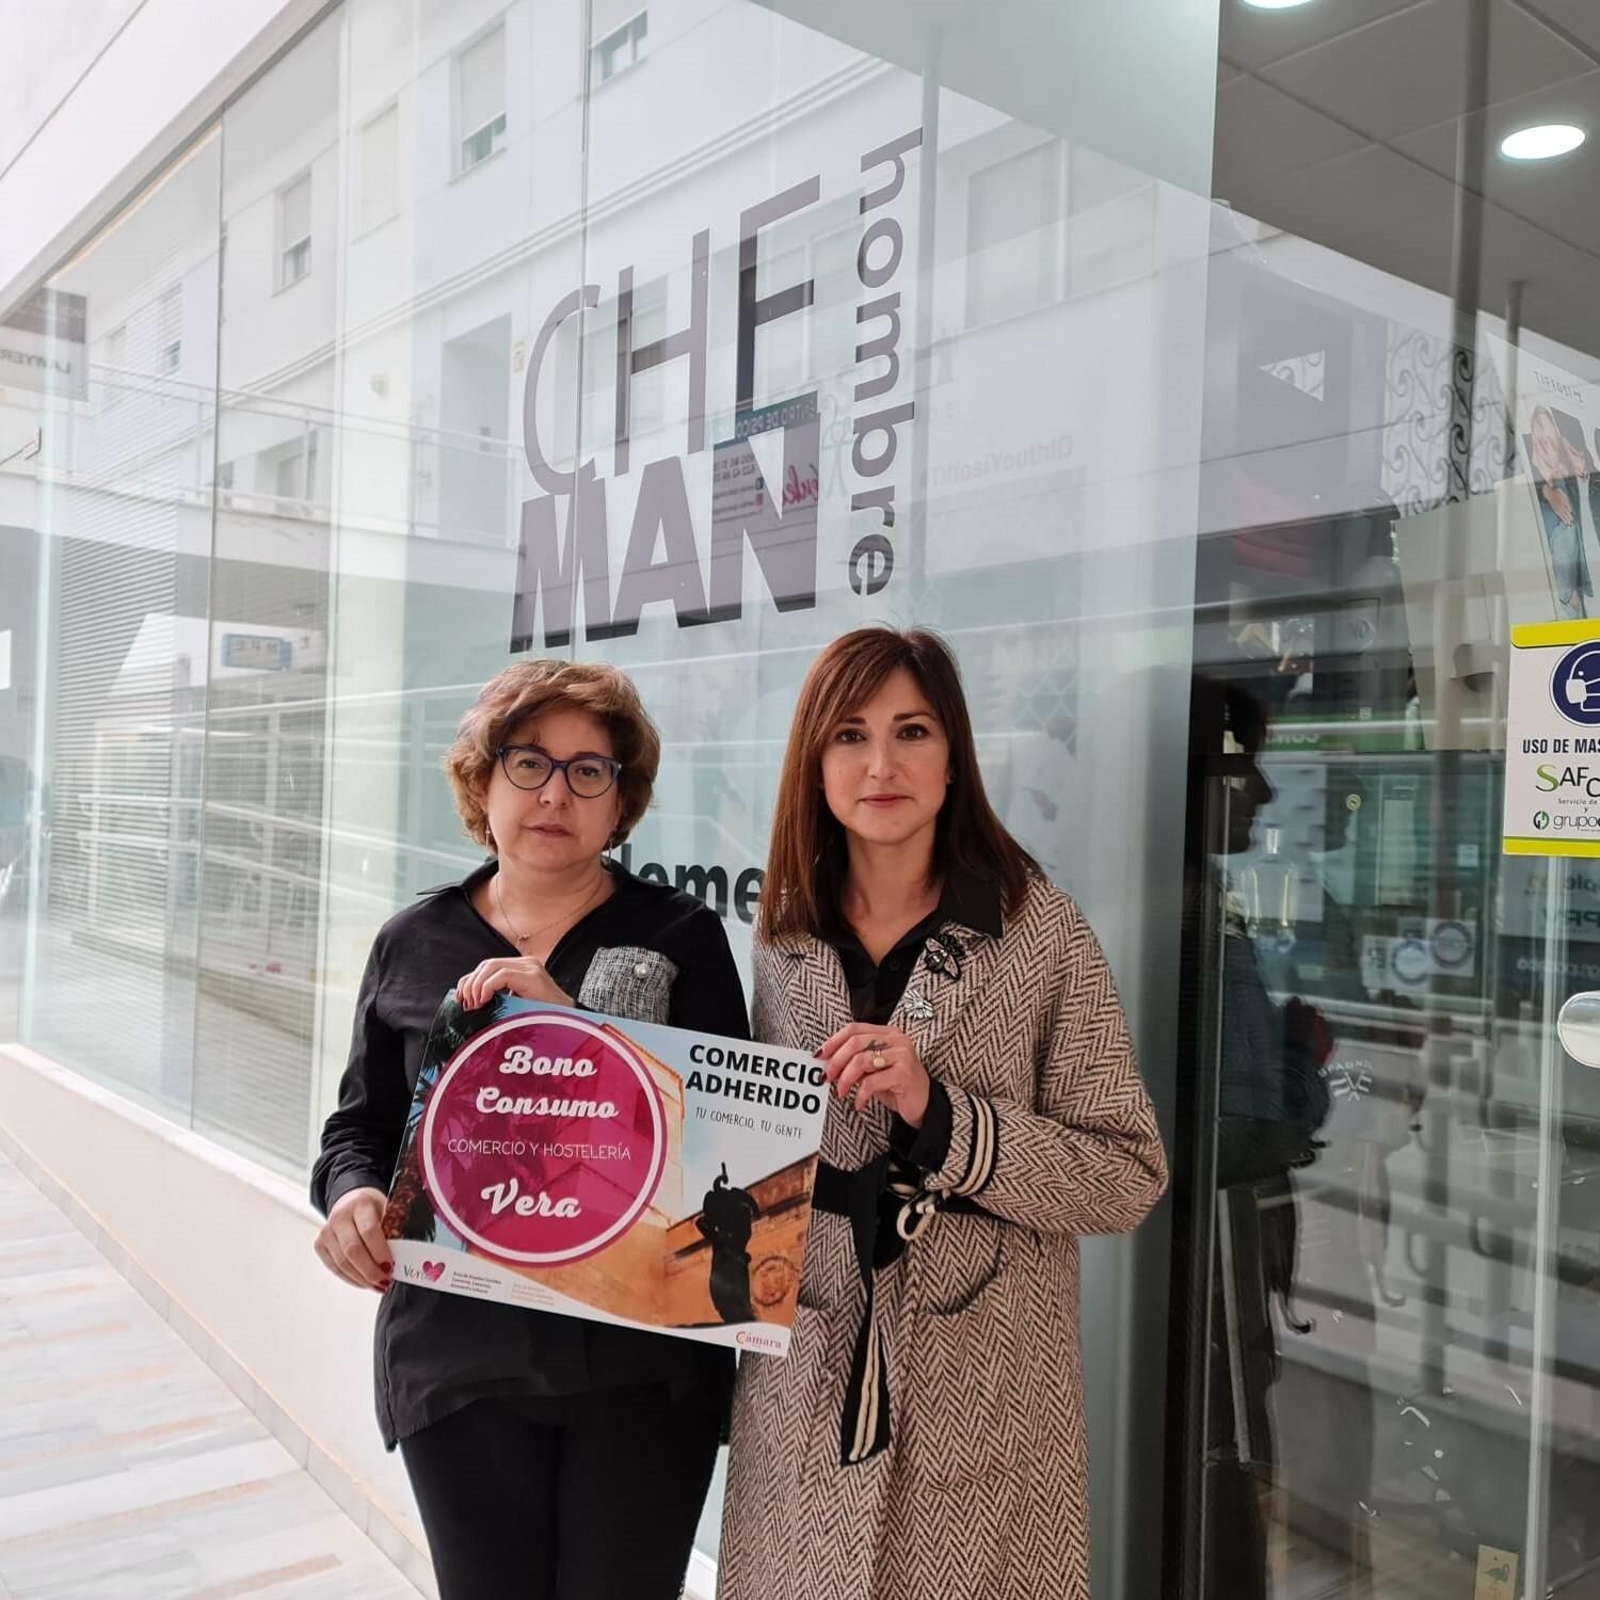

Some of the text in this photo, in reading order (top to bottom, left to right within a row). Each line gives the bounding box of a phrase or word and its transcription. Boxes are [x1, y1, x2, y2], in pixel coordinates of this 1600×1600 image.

[848, 127, 923, 596] hombre
[510, 412, 821, 653] MAN
[1523, 739, 1548, 754] USO
[1553, 739, 1569, 754] DE
[1558, 798, 1587, 806] Servicio
[499, 1045, 598, 1077] Bono
[690, 1045, 825, 1087] COMERCIO
[476, 1087, 619, 1119] Consumo
[686, 1071, 821, 1115] ADHERIDO
[695, 1107, 707, 1119] TU
[760, 1120, 772, 1132] TU
[775, 1124, 803, 1139] GENTE
[447, 1138, 632, 1161] COMERCIO Y HOSTELERÍA
[481, 1177, 582, 1218] Vera
